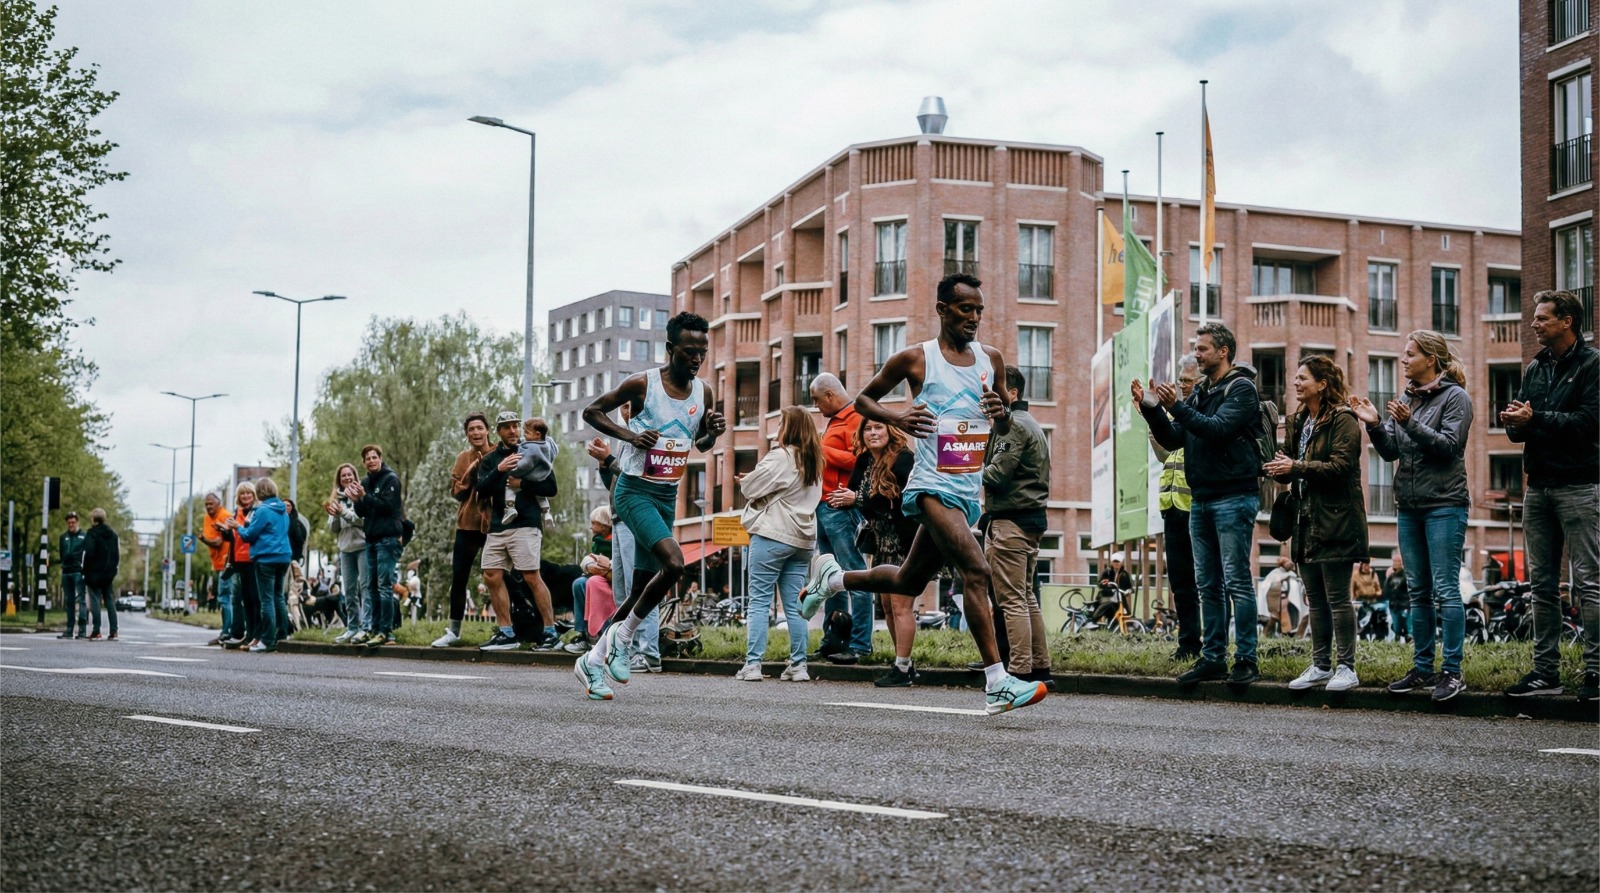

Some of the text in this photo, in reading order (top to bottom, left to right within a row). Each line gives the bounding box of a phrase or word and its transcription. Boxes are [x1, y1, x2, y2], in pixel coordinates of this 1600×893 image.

[942, 442, 986, 452] ASMARE
[650, 454, 687, 467] WAISS
[962, 453, 971, 462] 4
